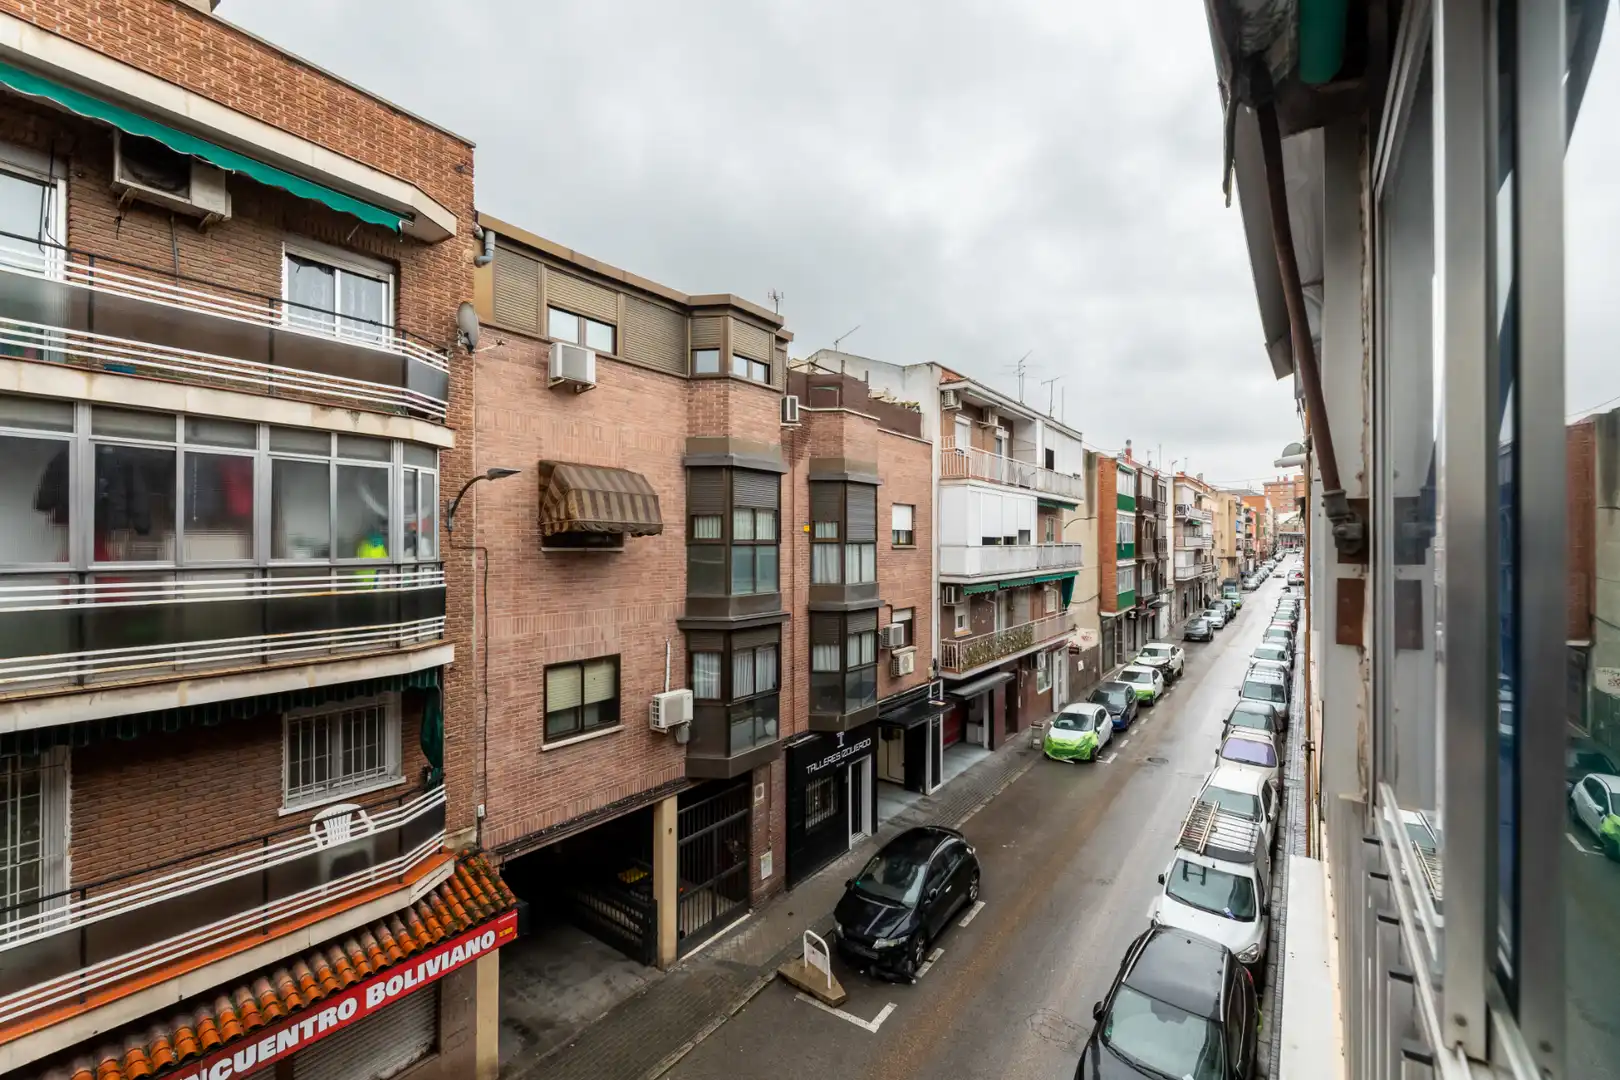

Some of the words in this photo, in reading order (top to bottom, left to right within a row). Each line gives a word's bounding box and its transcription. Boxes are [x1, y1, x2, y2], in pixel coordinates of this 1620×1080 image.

[806, 753, 841, 774] TALLERES
[180, 997, 359, 1080] CUENTRO
[366, 930, 496, 1009] BOLIVIANO
